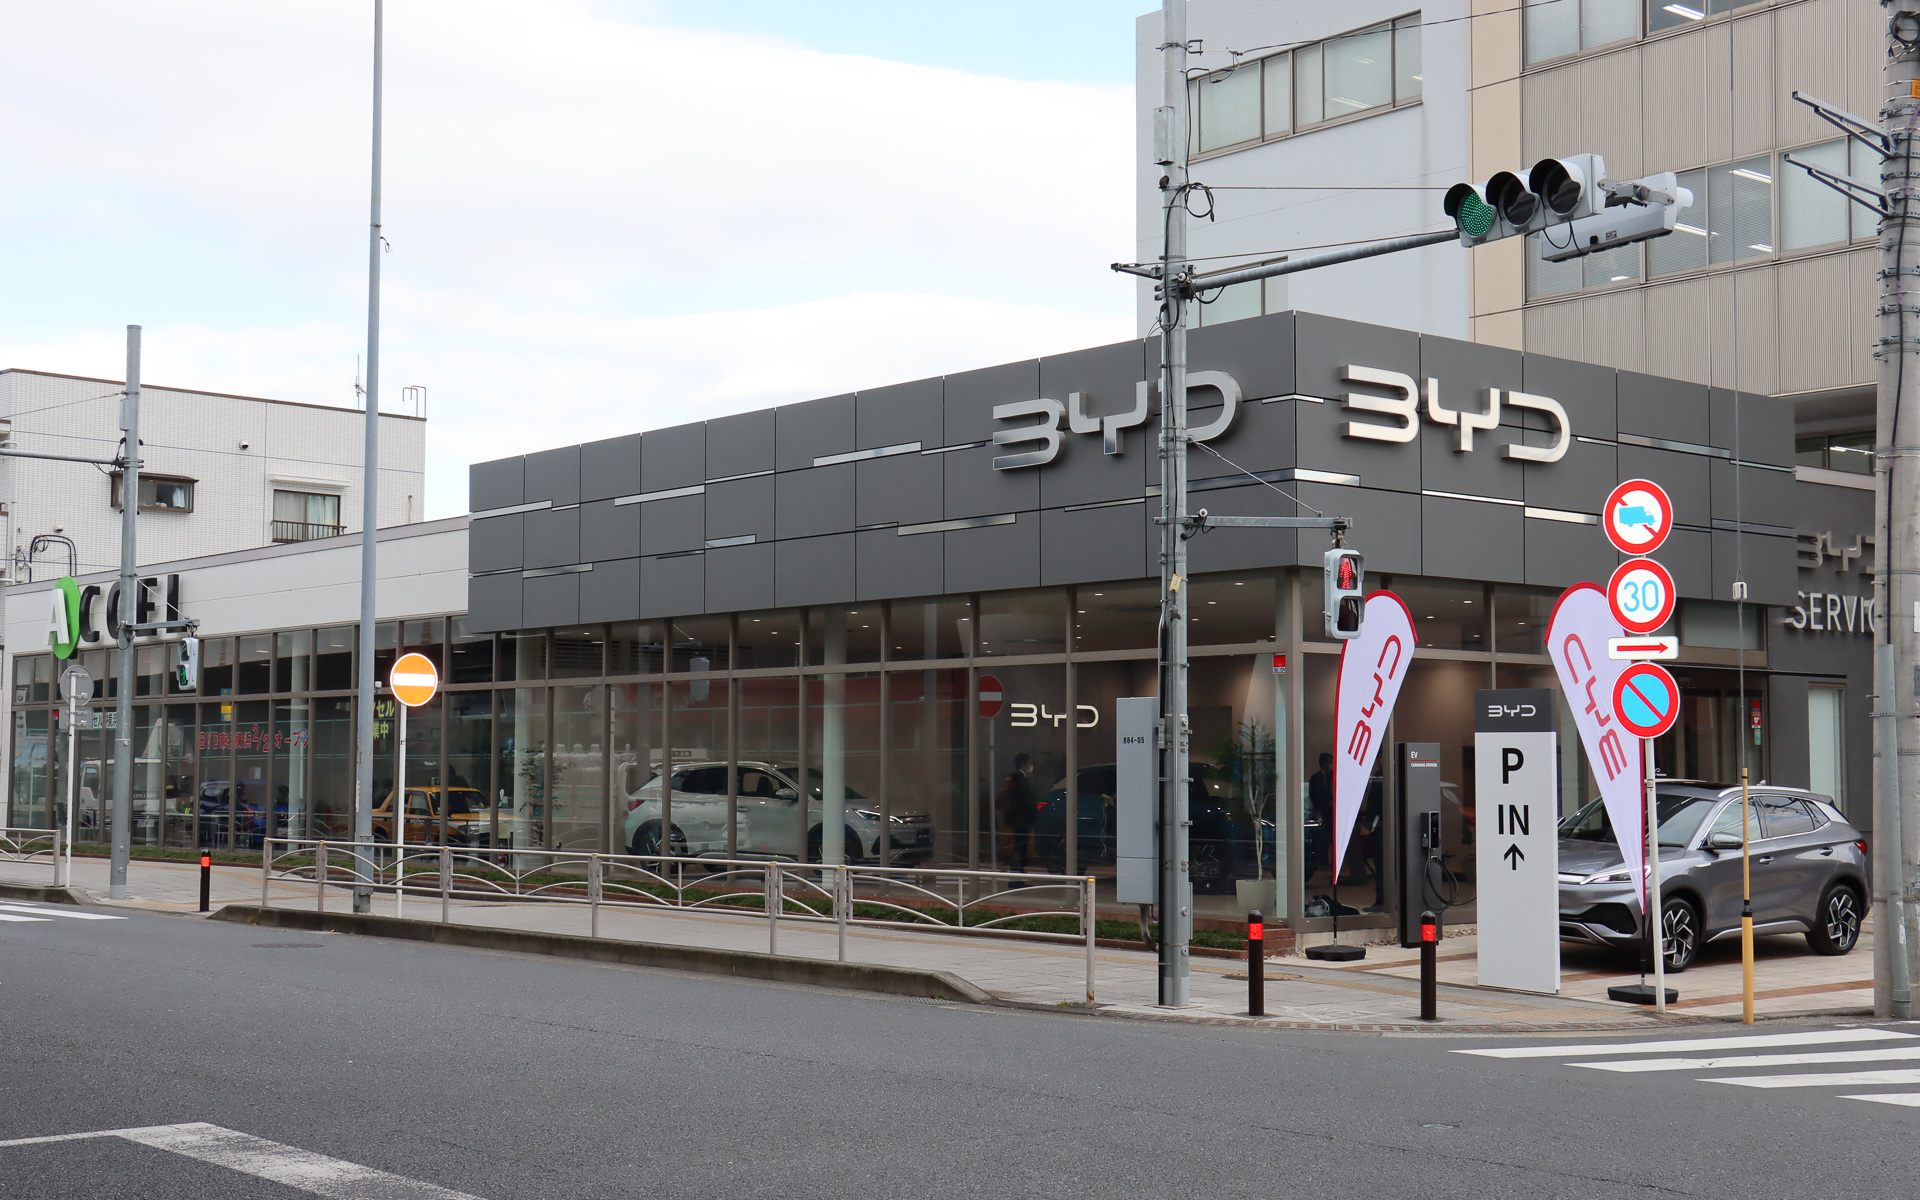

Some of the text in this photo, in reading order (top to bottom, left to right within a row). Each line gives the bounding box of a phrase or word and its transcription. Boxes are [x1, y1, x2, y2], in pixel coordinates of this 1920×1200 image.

[993, 369, 1242, 470] BYD
[1340, 364, 1571, 463] BYD
[1623, 580, 1659, 612] 30
[373, 700, 395, 718] セル
[1011, 703, 1099, 728] BYD
[1348, 634, 1401, 766] BYD
[1488, 704, 1536, 718] BYD
[1123, 736, 1145, 744] 884-05
[1410, 751, 1418, 759] EV
[1501, 747, 1525, 785] P
[1497, 804, 1530, 836] IN
